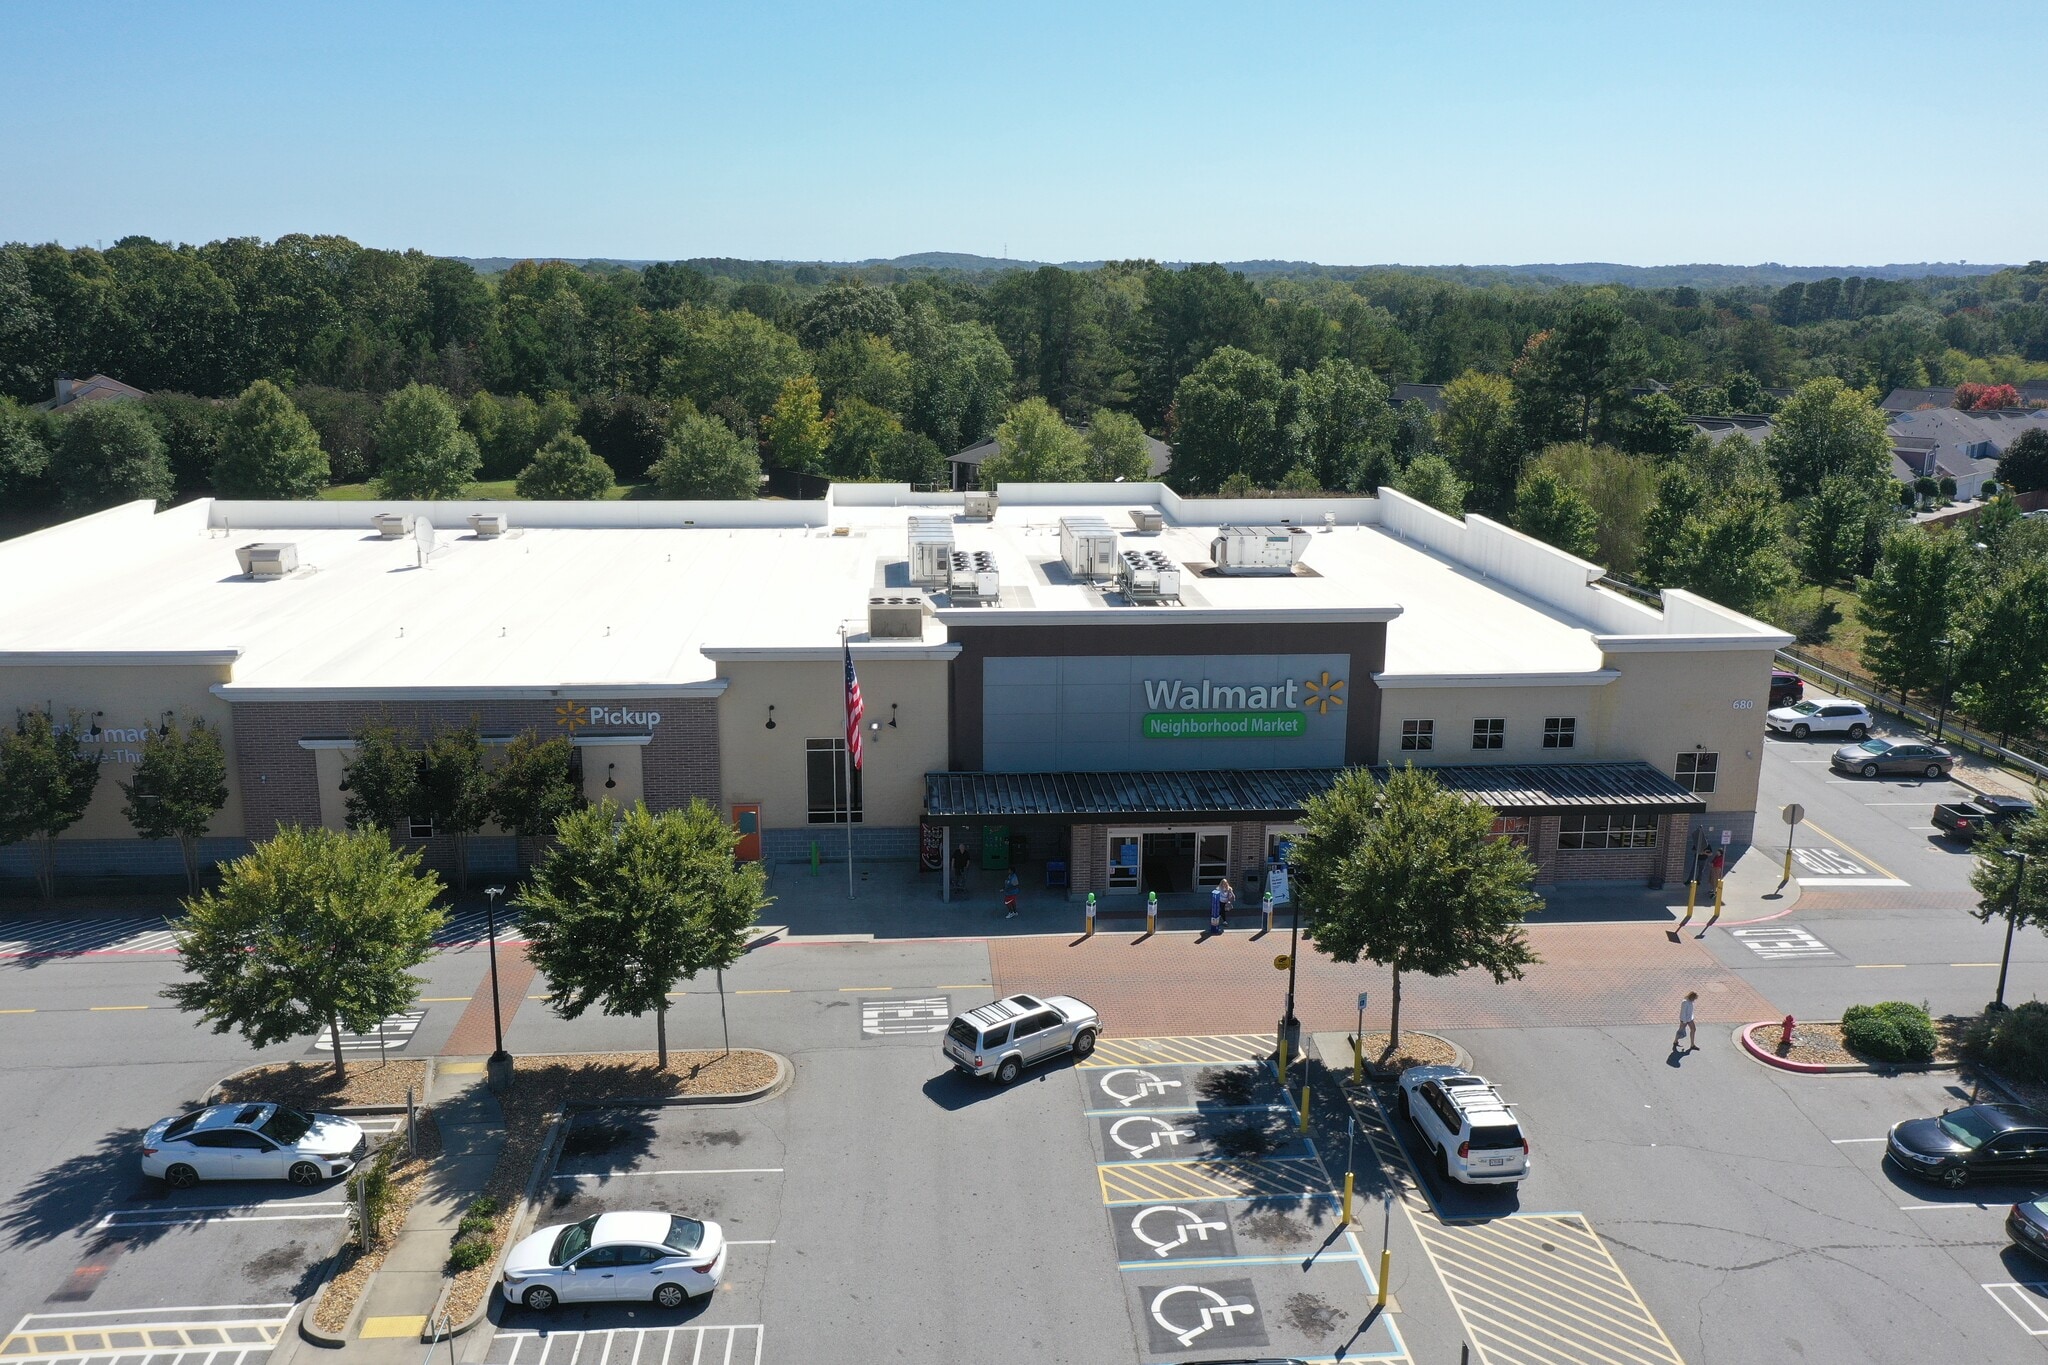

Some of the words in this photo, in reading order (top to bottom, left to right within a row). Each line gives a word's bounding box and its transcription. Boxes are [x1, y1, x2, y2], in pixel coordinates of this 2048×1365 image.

[1144, 679, 1298, 710] Walmart
[1732, 699, 1754, 710] 680
[590, 706, 661, 730] Pickup
[1150, 717, 1248, 736] Neighborhood
[1251, 717, 1298, 732] Market
